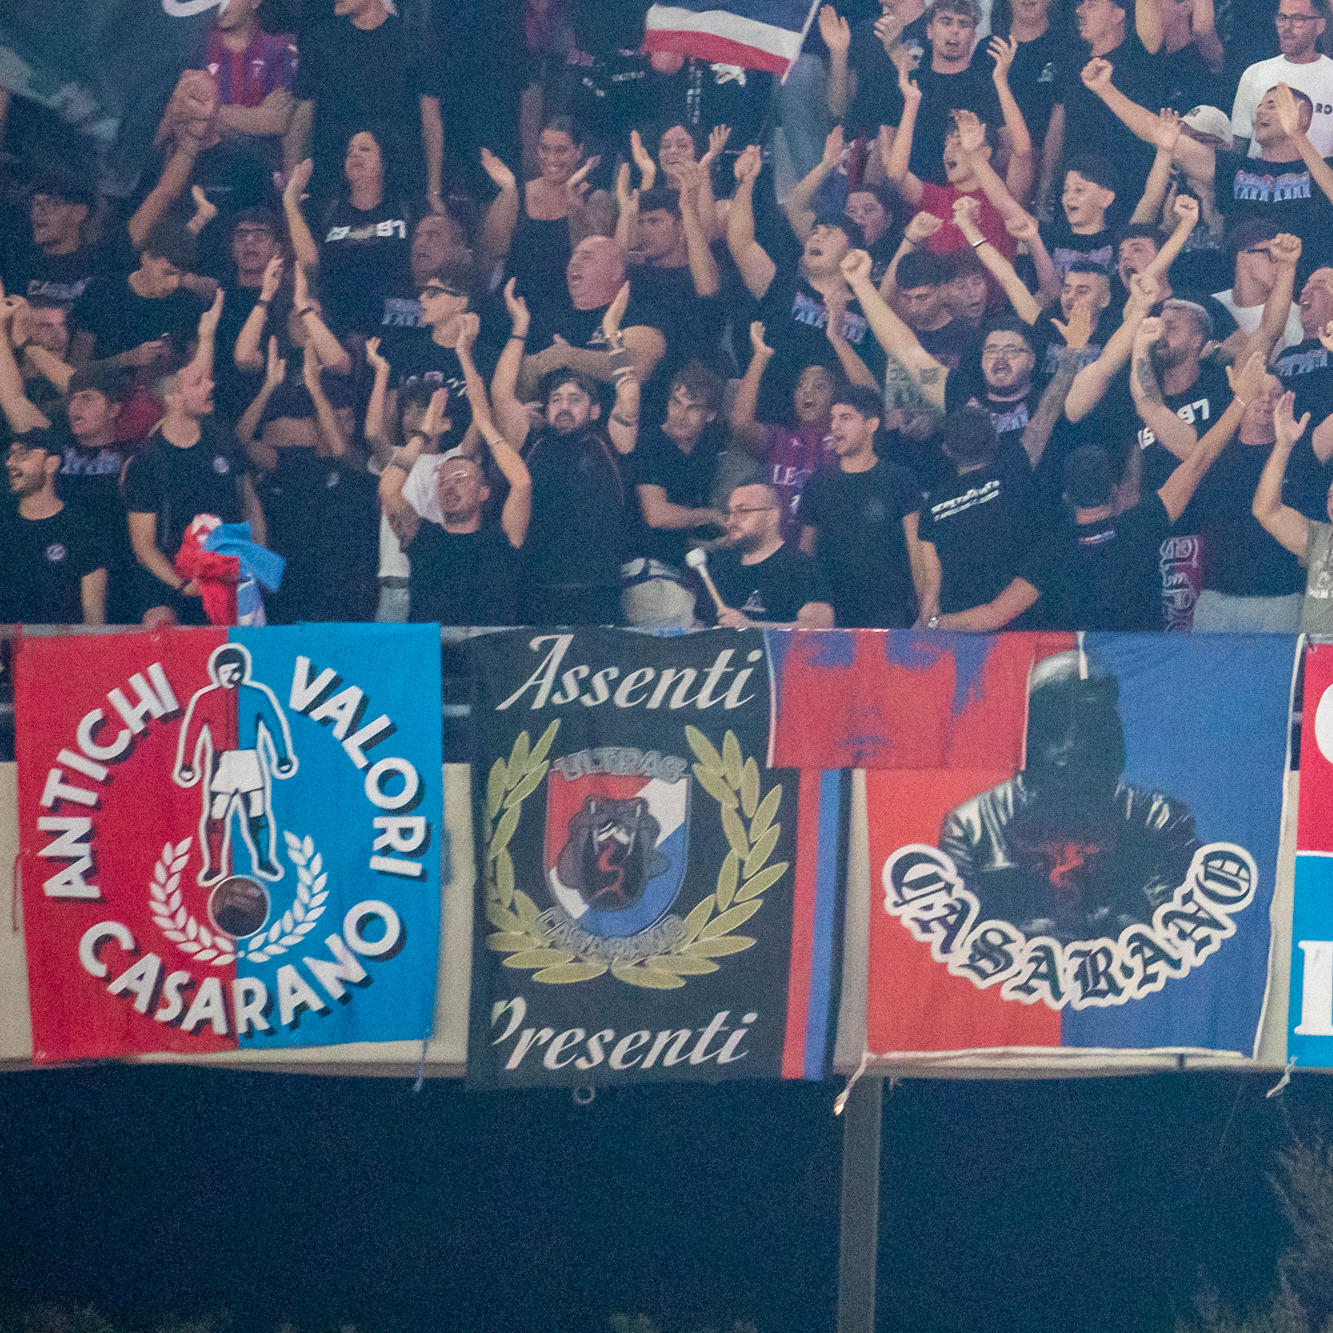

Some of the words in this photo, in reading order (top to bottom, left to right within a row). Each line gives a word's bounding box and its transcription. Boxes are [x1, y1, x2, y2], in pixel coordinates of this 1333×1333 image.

[1176, 398, 1210, 425] 97
[496, 634, 763, 712] Assenti
[37, 662, 182, 903] ANTICHI
[289, 655, 427, 879] VALORI
[77, 899, 402, 1037] CASARANO
[883, 842, 1259, 1010] CASARANO
[489, 995, 759, 1071] Presenti
